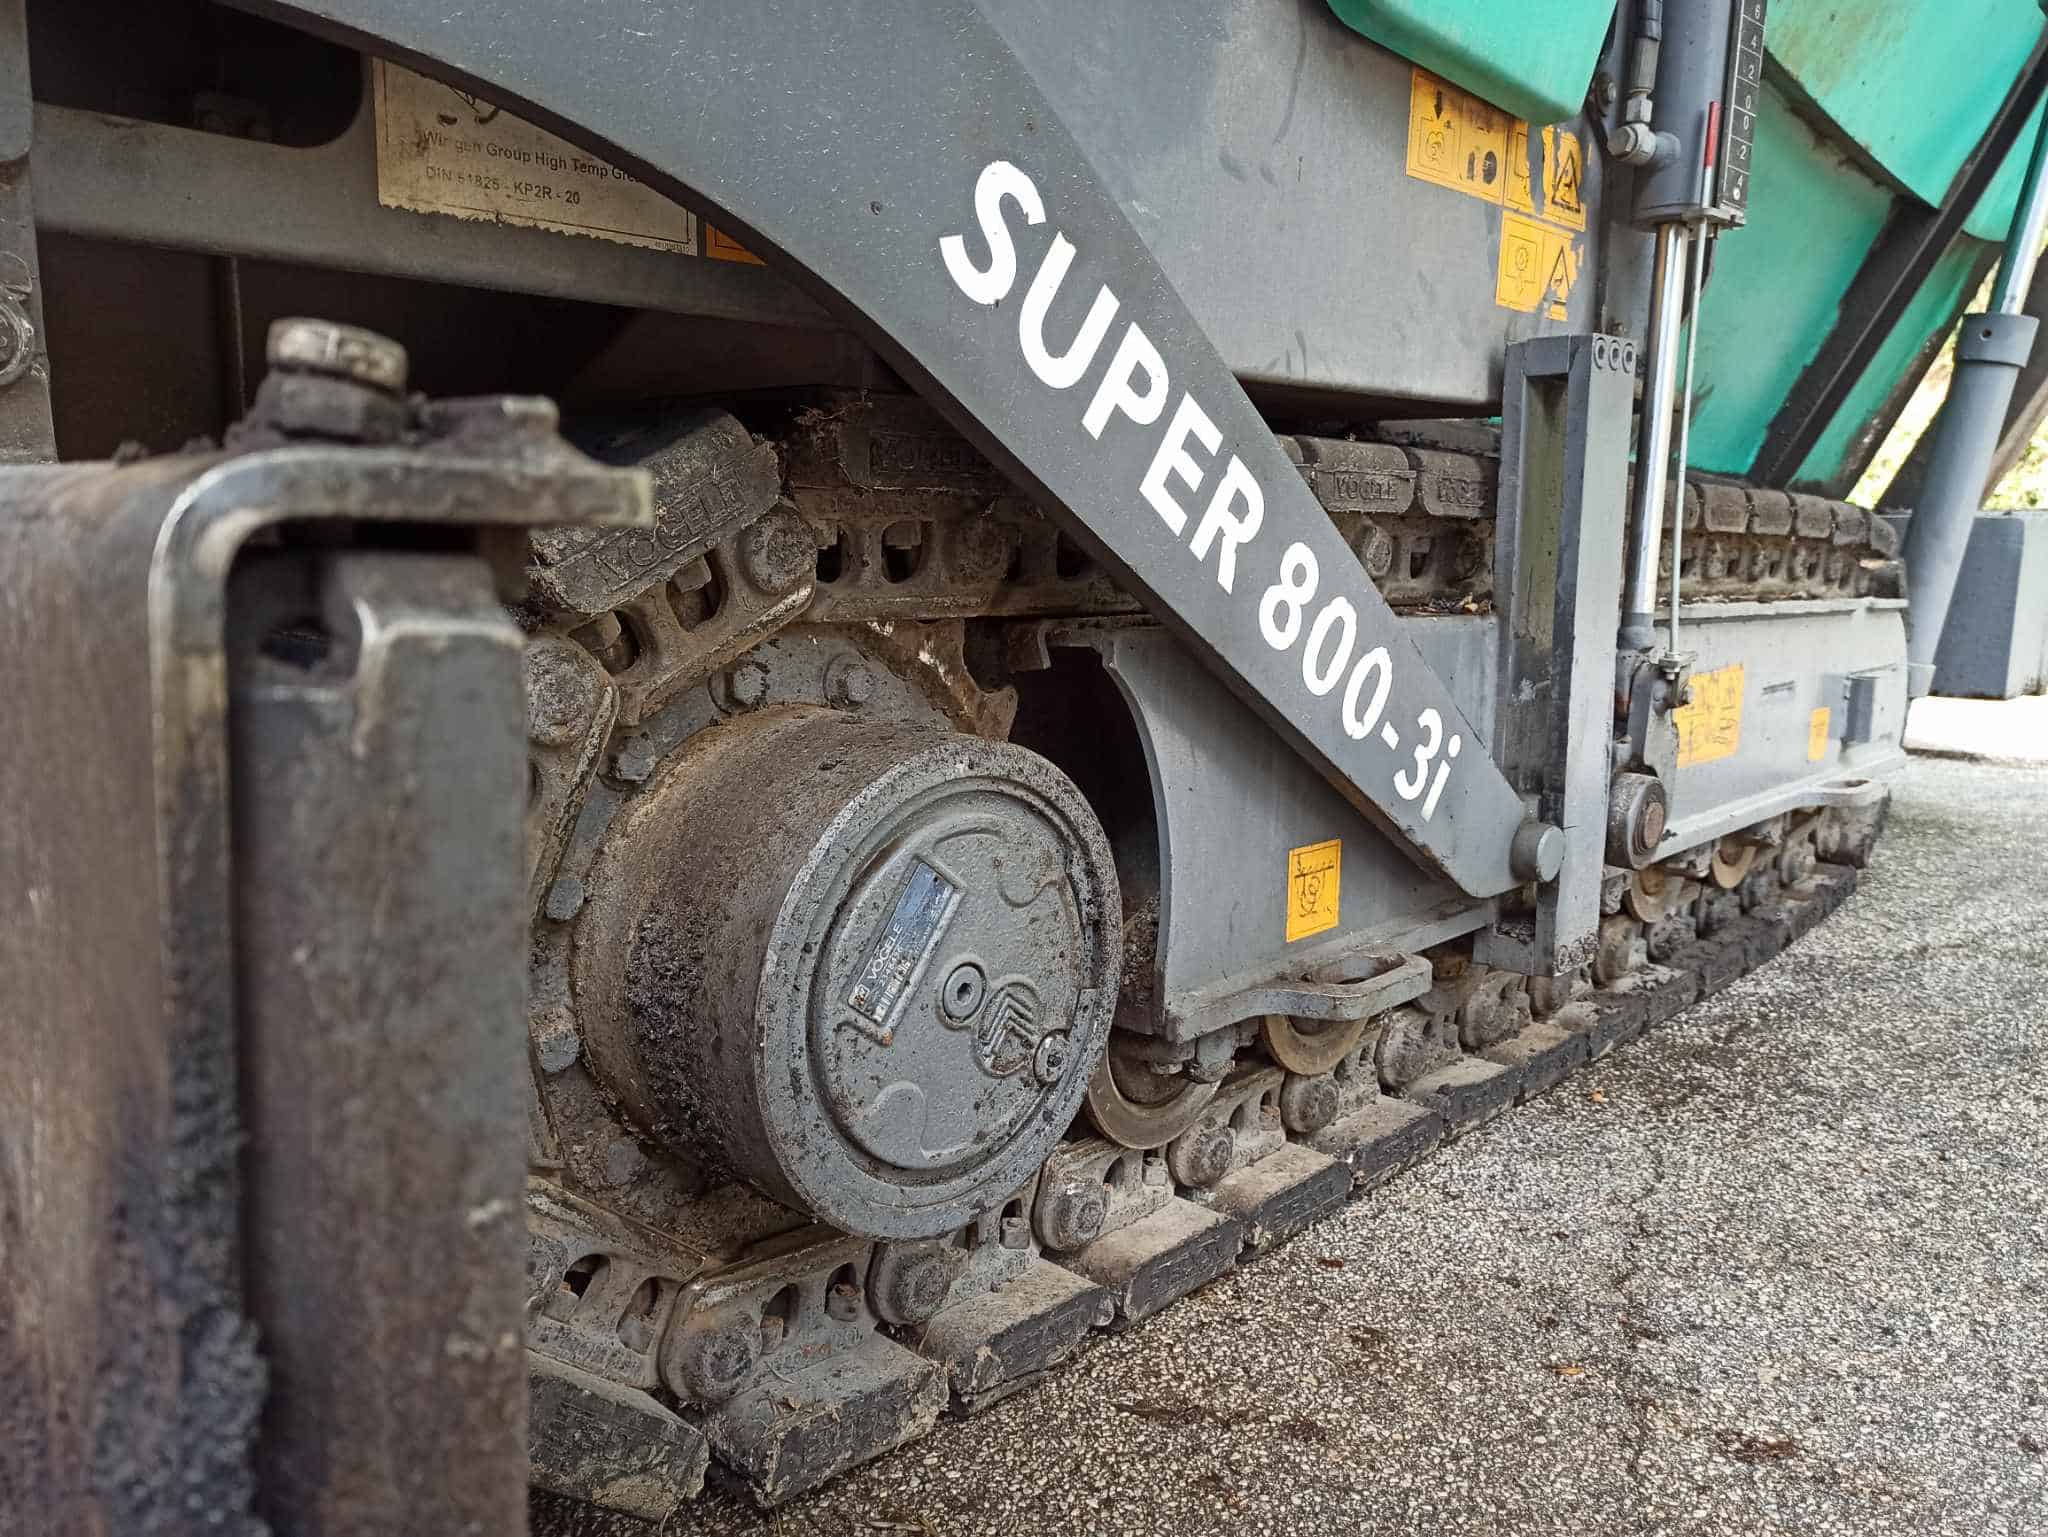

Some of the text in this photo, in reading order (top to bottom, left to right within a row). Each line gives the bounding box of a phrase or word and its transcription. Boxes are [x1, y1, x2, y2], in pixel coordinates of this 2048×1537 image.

[1748, 64, 1755, 80] 2
[1745, 95, 1752, 110] 0
[1743, 115, 1750, 130] 0
[1740, 144, 1747, 160] 2
[486, 142, 532, 166] Group
[535, 151, 567, 171] High
[571, 158, 609, 181] Temp
[425, 166, 452, 181] DIN
[513, 180, 554, 201] KP2R
[566, 189, 581, 205] 20
[939, 160, 1462, 823] SUPER 800-3i
